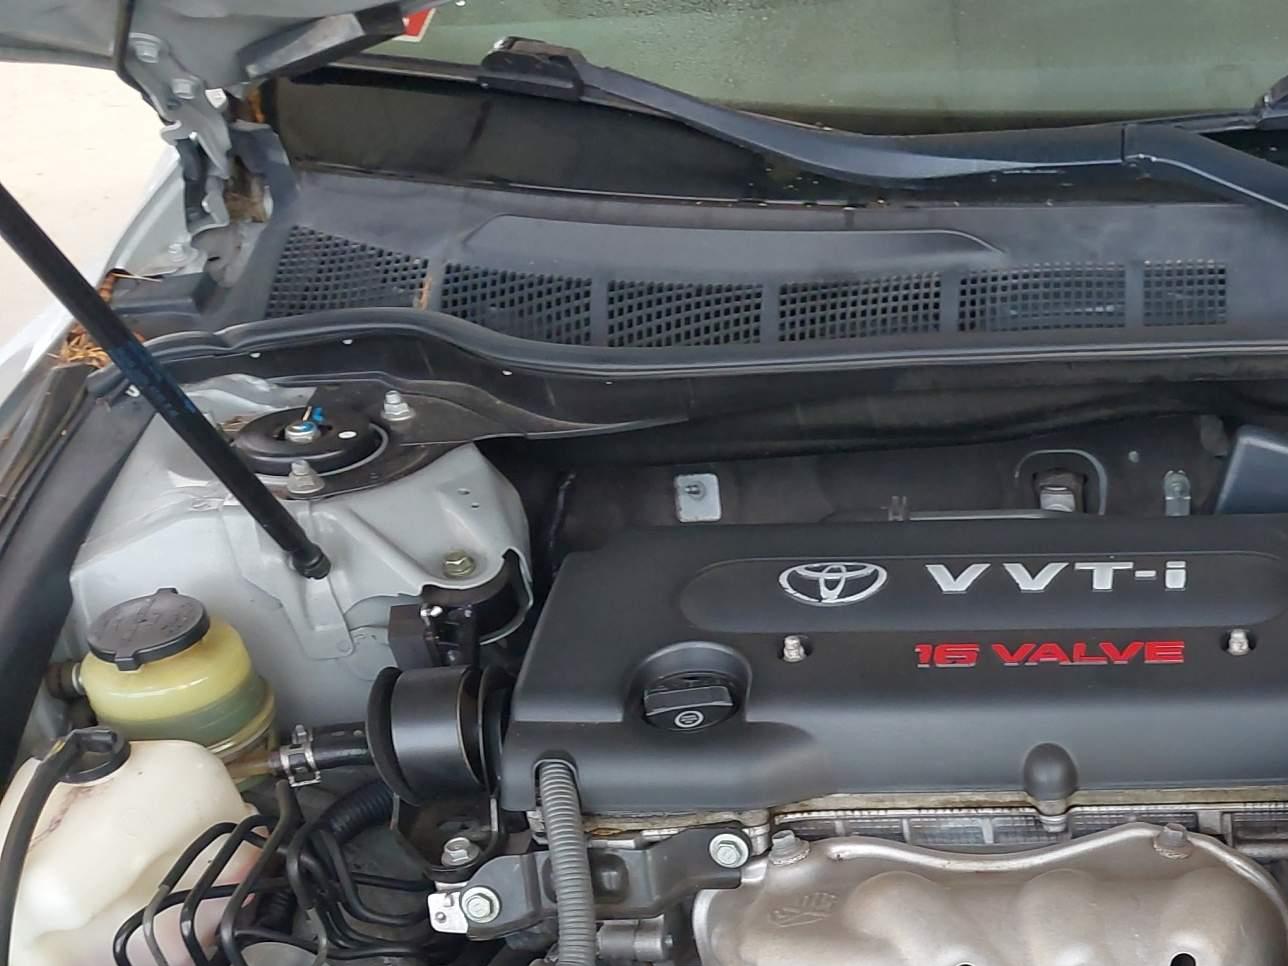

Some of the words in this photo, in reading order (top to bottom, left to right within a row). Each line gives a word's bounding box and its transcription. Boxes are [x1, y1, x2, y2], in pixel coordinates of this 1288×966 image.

[925, 561, 1187, 593] VVT-i
[915, 643, 980, 668] 16
[992, 641, 1186, 666] VALVE
